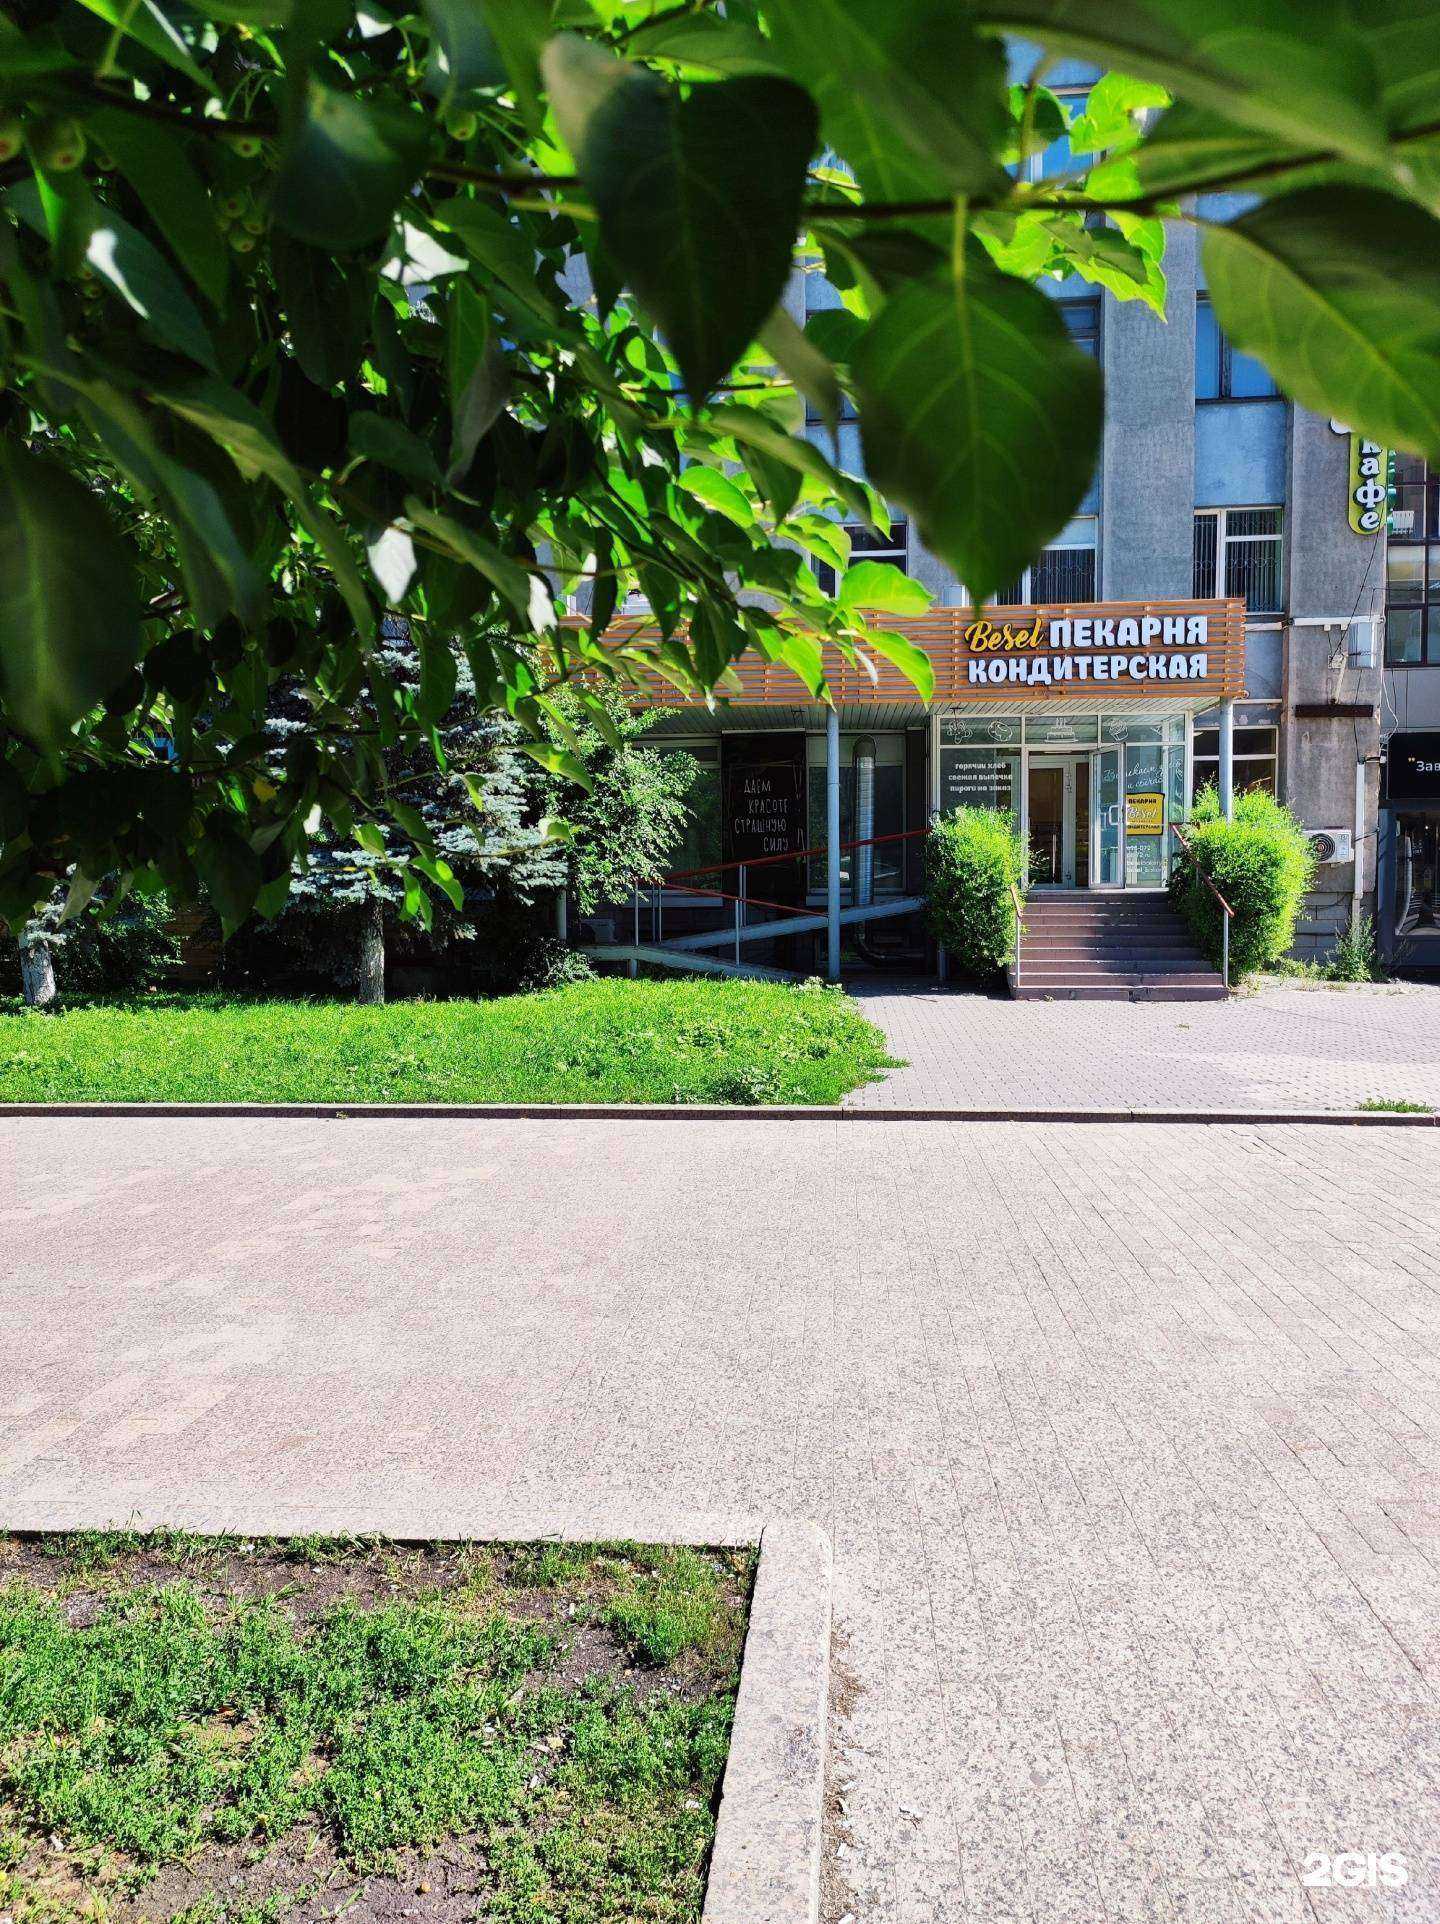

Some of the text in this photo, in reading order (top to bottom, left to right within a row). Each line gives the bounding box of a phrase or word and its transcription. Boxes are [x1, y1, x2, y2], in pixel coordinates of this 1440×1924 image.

[1049, 616, 1208, 648] ПЕКАРНЯ
[968, 653, 1208, 685] КОНДИТЕРСКАЯ
[950, 785, 977, 793] пироги
[748, 799, 788, 813] КРАСОТЕ
[734, 818, 787, 833] СТРАШНУЮ
[763, 837, 788, 852] СИЛУ
